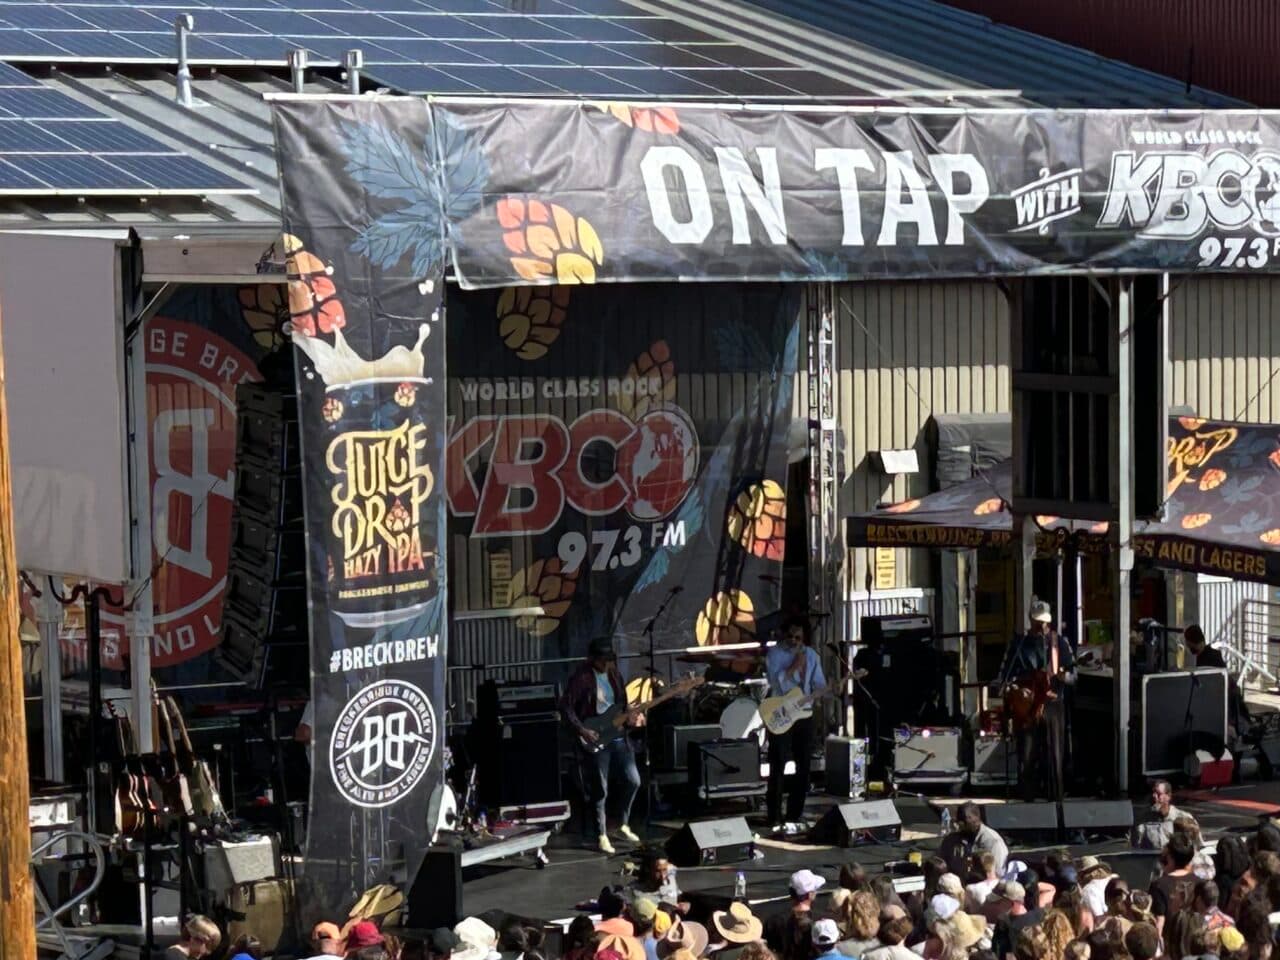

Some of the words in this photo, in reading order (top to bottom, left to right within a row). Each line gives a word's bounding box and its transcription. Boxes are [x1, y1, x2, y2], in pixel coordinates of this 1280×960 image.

[1131, 130, 1182, 145] WORLD
[1183, 129, 1226, 145] CLASS
[1227, 130, 1263, 145] ROCK
[640, 145, 788, 245] ON
[814, 147, 990, 247] TAP
[1014, 174, 1081, 226] WITH
[1198, 236, 1269, 269] 97.3
[459, 381, 535, 401] WORLD
[541, 378, 600, 399] CLASS
[606, 377, 663, 397] ROCK
[325, 417, 428, 505] JUICE
[445, 403, 700, 539] KBCO
[331, 470, 434, 561] DROP
[343, 544, 383, 580] HAZY
[387, 525, 426, 574] IPA
[557, 524, 643, 574] 97.3
[650, 519, 687, 547] FM
[1157, 540, 1196, 566] AND
[1199, 547, 1267, 578] LAGERS
[329, 633, 440, 673] #BRECKBREW
